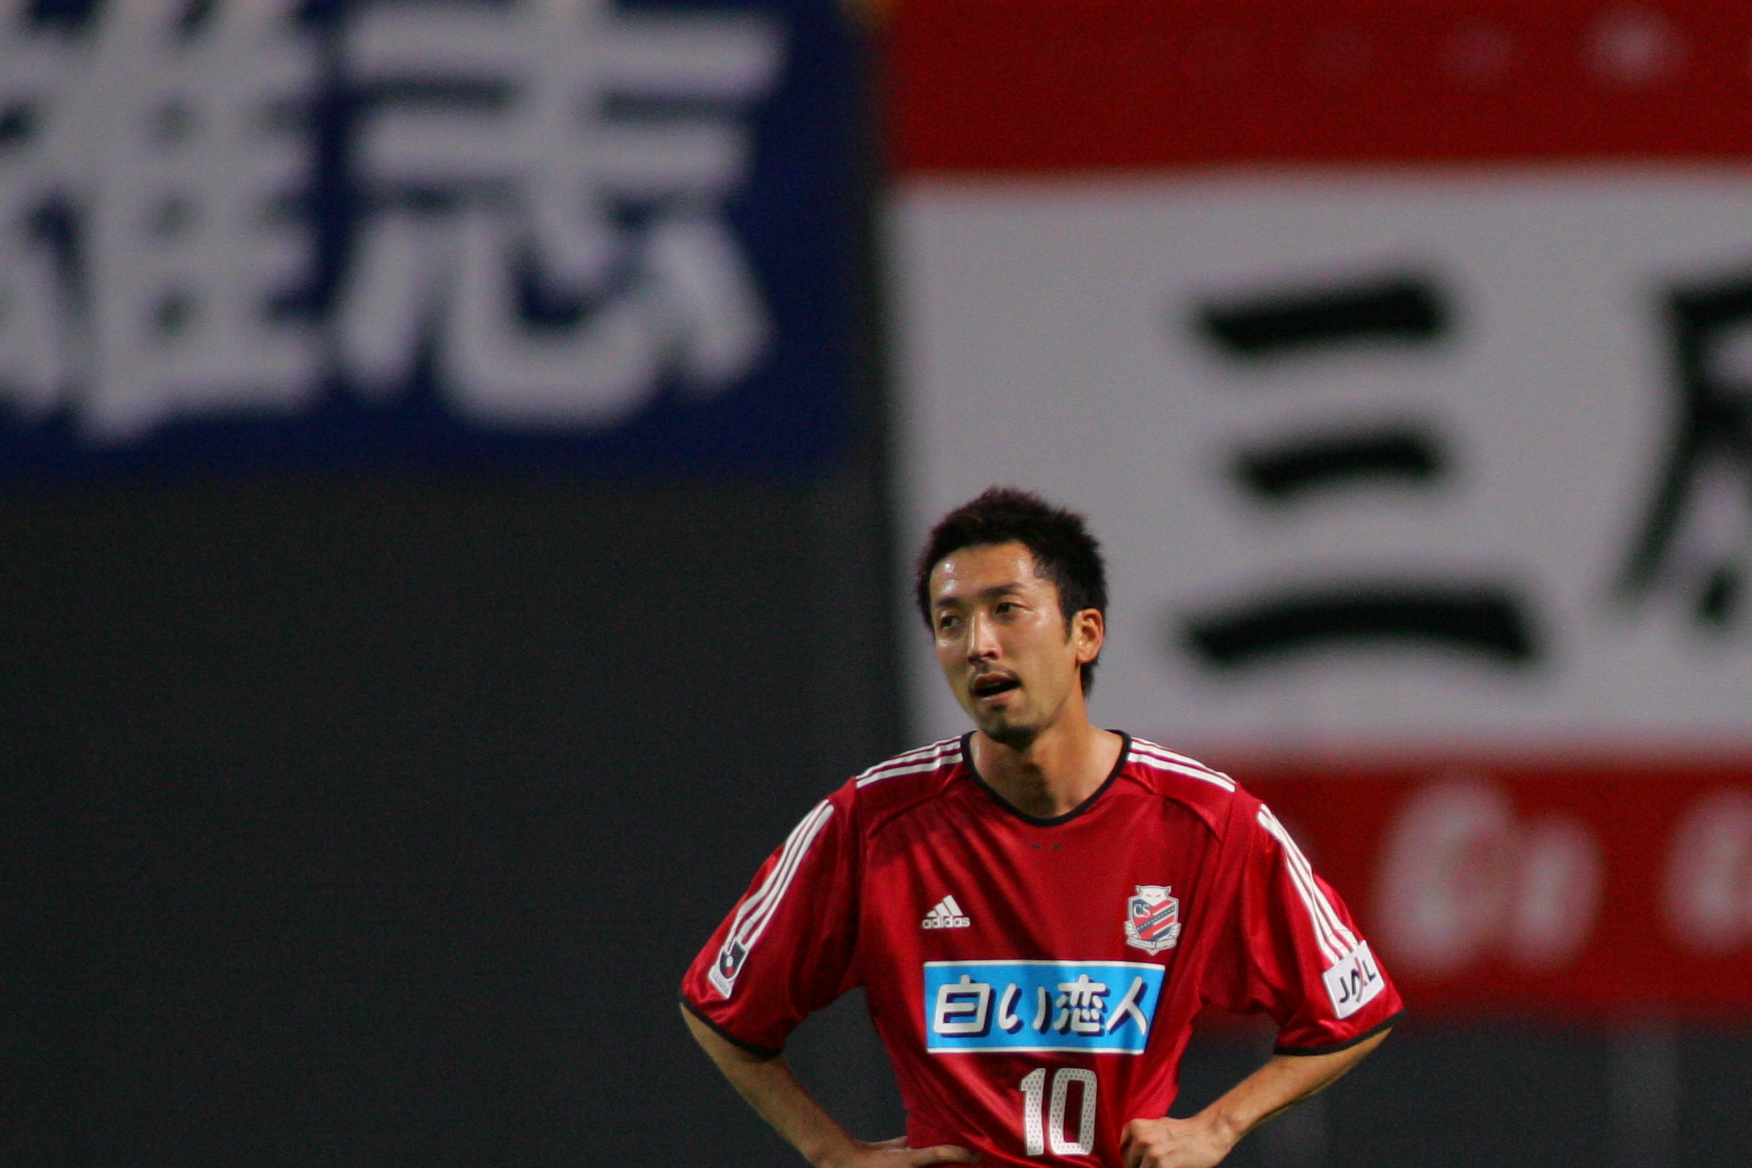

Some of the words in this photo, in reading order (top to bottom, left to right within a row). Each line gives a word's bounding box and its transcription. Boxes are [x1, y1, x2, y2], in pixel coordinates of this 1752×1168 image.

[922, 914, 971, 930] adidas
[931, 973, 1150, 1038] 白い恋人
[1339, 956, 1377, 1003] JAL
[1019, 1067, 1098, 1157] 10
